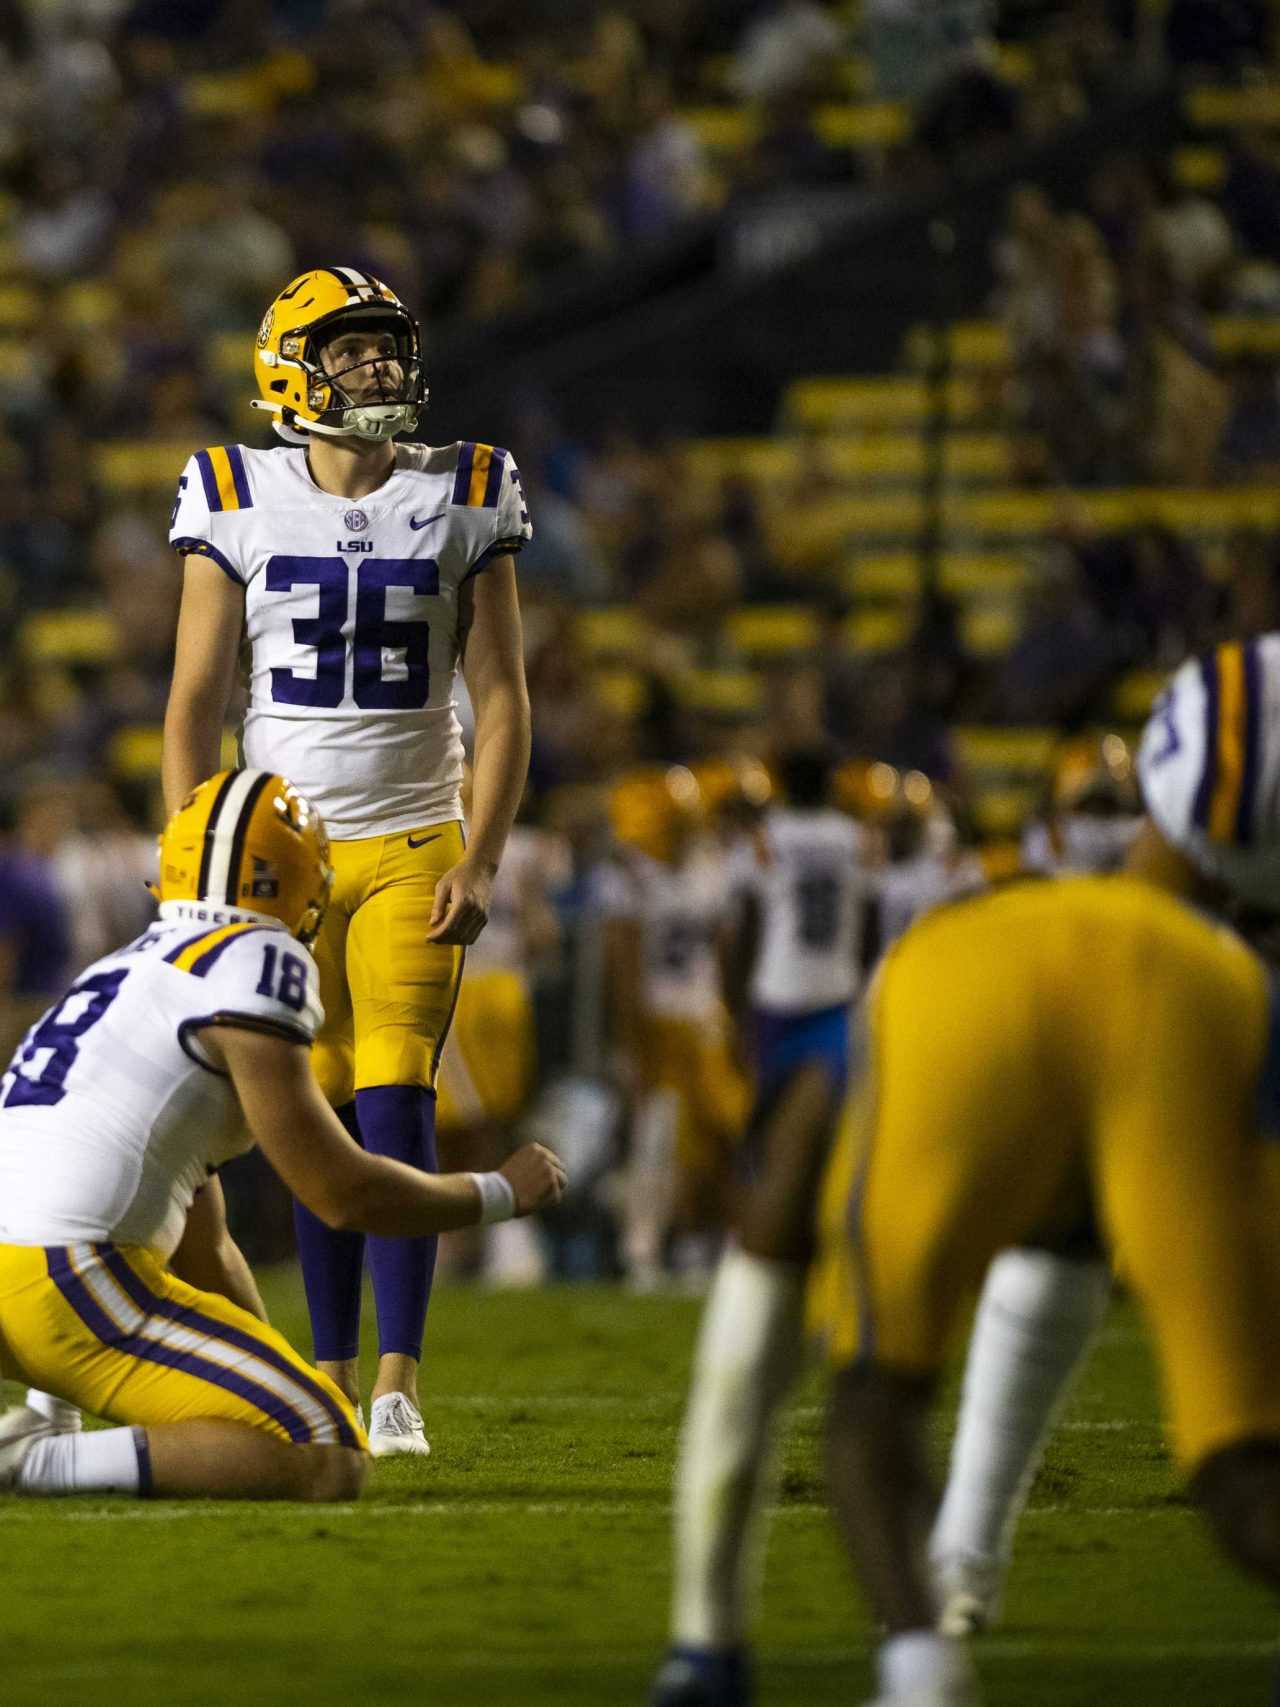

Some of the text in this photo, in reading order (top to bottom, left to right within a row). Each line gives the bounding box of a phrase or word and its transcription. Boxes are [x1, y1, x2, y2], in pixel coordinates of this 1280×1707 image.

[336, 541, 374, 553] LSU
[265, 555, 440, 710] 36
[256, 943, 308, 1011] 18
